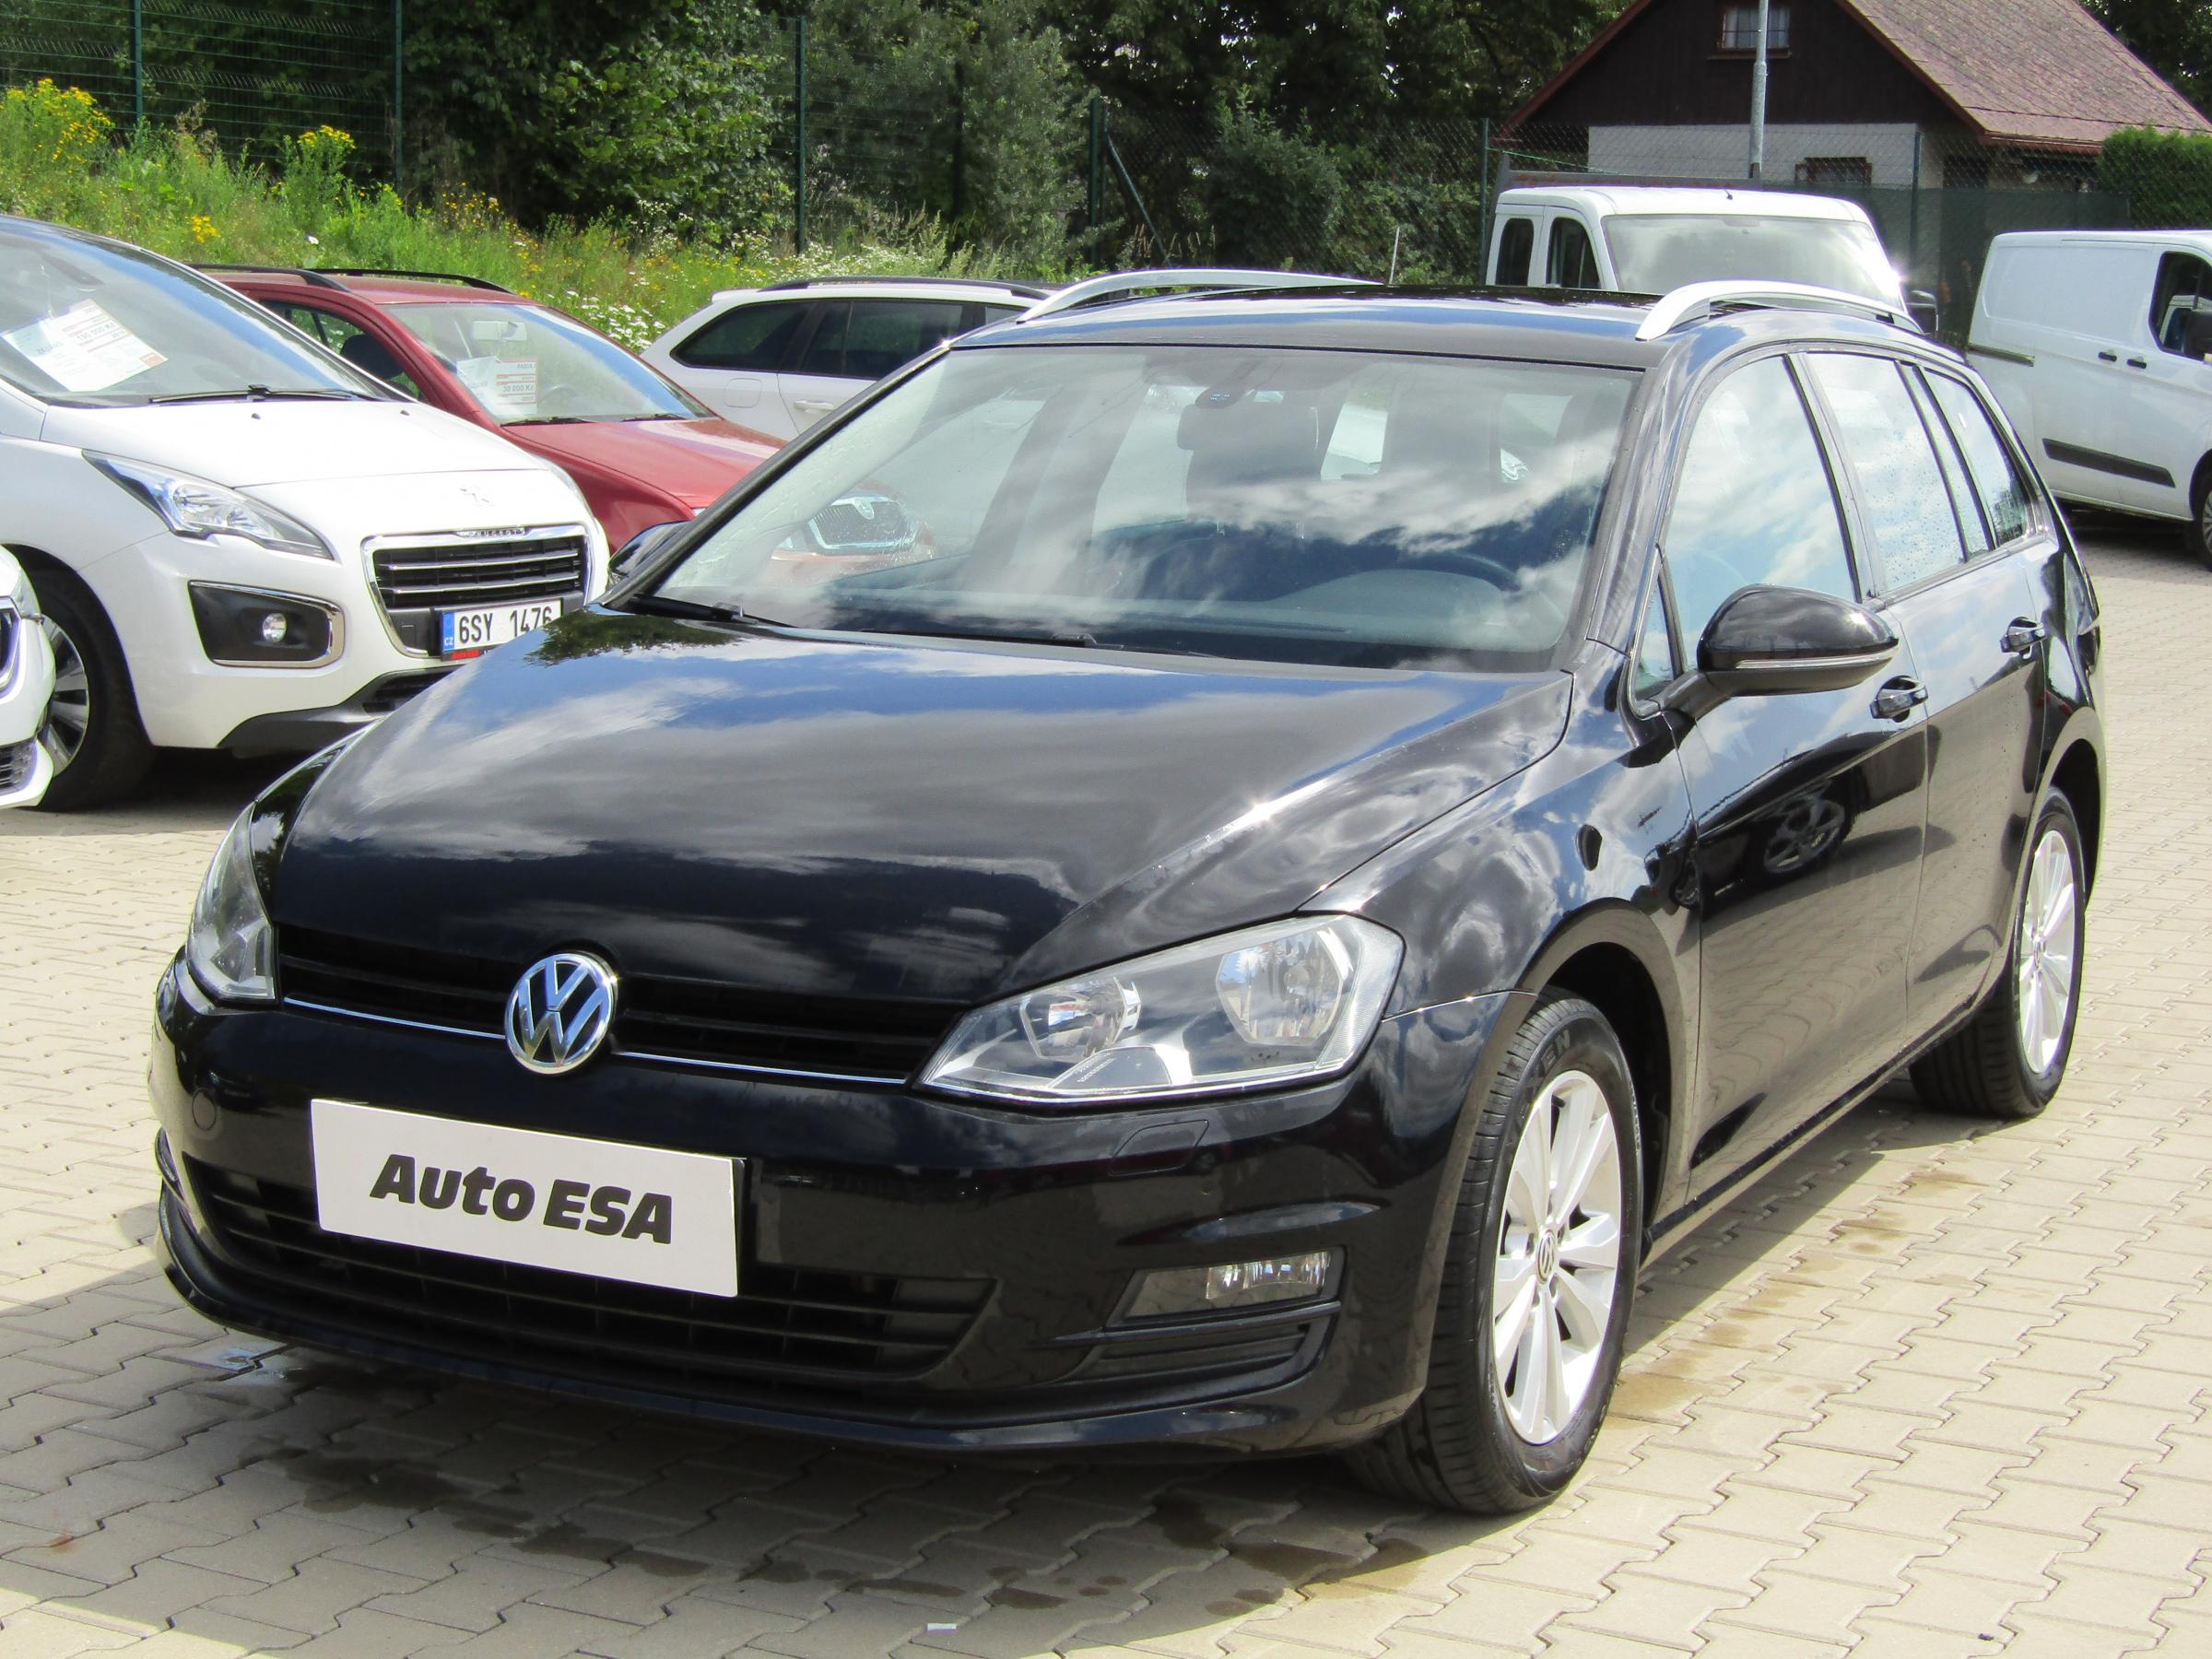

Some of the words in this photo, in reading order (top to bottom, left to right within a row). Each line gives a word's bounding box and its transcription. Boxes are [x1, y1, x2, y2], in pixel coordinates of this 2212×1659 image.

[444, 637, 453, 645] CZ
[459, 613, 493, 643] 6SY
[510, 606, 552, 637] 1476
[370, 1154, 535, 1222] Auto
[543, 1179, 672, 1244] ESA
